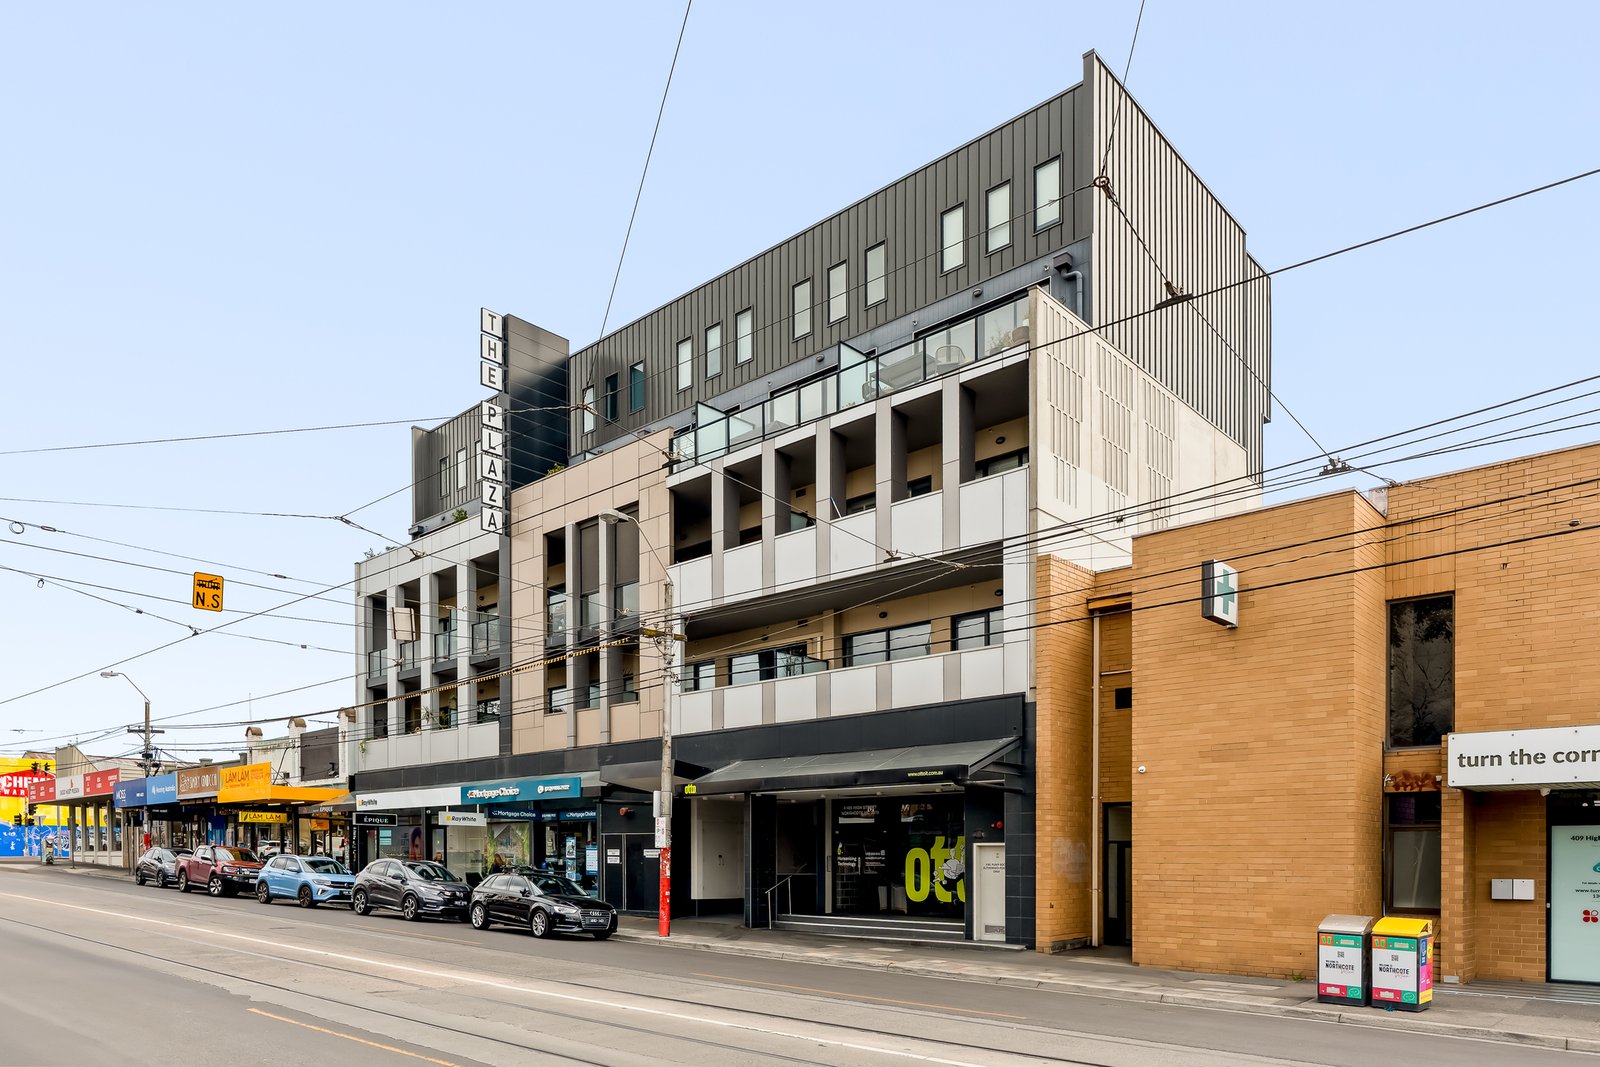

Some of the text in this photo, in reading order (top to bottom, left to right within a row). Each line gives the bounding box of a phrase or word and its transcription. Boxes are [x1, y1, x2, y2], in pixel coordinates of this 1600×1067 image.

[488, 313, 498, 529] THE PLAZA
[1457, 753, 1502, 768] turn
[1508, 748, 1546, 765] the
[475, 786, 520, 799] Mortgage Choice
[363, 815, 389, 824] ÉPIQUE
[497, 810, 520, 819] Mortgage
